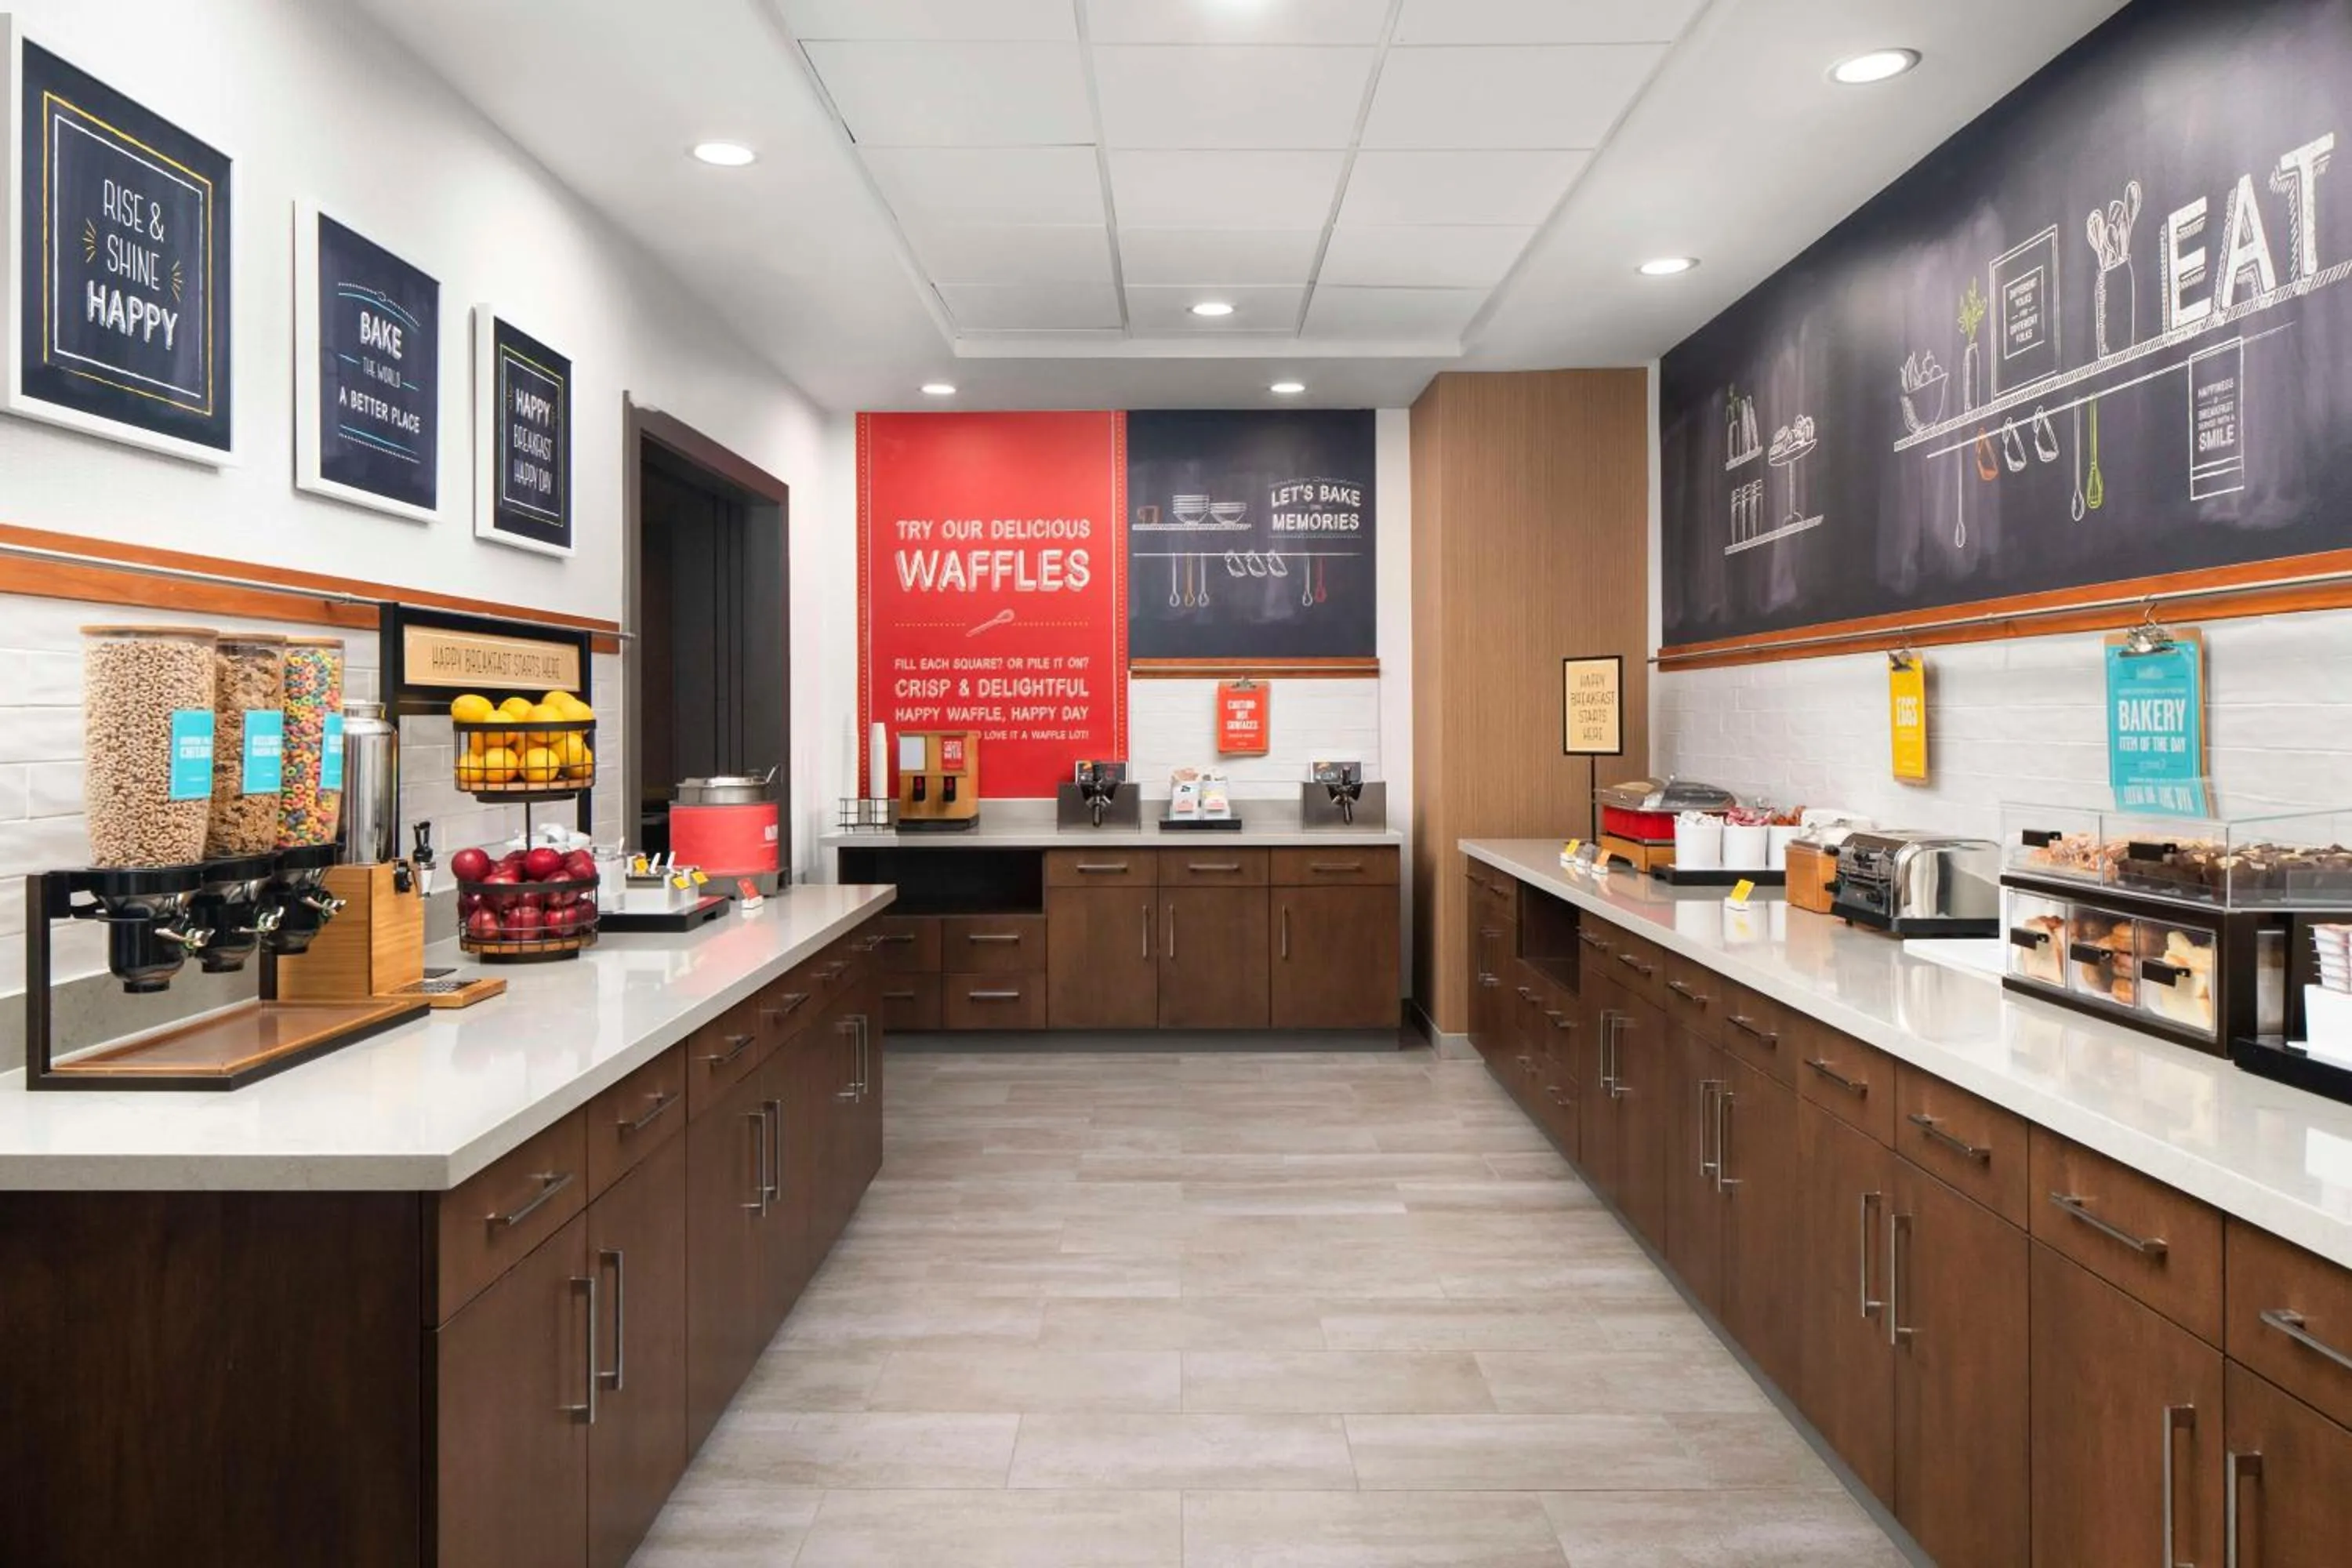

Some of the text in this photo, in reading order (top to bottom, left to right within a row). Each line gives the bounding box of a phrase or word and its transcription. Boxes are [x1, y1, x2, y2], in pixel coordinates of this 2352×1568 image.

[103, 179, 165, 243] RISE &
[2160, 132, 2335, 335] EAT
[107, 234, 161, 292] SHINE
[86, 280, 178, 350] HAPPY
[2009, 314, 2038, 336] DIFFERENT
[360, 311, 402, 361] BAKE
[2015, 328, 2033, 347] FOLKS
[363, 357, 401, 388] THE WORLD
[2198, 377, 2234, 399] HAPPINESS
[339, 385, 420, 434] A BETTER PLACE
[515, 388, 551, 428] HAPPY
[514, 423, 553, 463] BREAKFAST
[2198, 424, 2235, 452] SMILE
[514, 459, 553, 495] HAPPY DAY
[1271, 485, 1362, 508] LET'S BAKE
[896, 518, 1091, 541] TRY OUR DELICIOUS
[1272, 513, 1360, 531] MEMORIES
[895, 548, 1091, 593] WAFFLES
[432, 644, 561, 680] HAPPY BREAKFAST STARTS HERE
[895, 656, 1090, 670] FILL EACH SQUARE? OR PILE IT ON?
[895, 677, 1089, 699] CRISP & DELIGHTFUL
[1580, 673, 1606, 688] HAPPY
[1570, 691, 1615, 706] BREAKFAST
[895, 706, 1090, 723] HAPPY WAFFLE, HAPPY DAY
[1578, 709, 1607, 724] STARTS
[2118, 699, 2186, 732] BAKERY
[984, 729, 1090, 740] LOVE IT A WAFFLE LOT!
[2118, 735, 2187, 753] ITEM OF THE DAY
